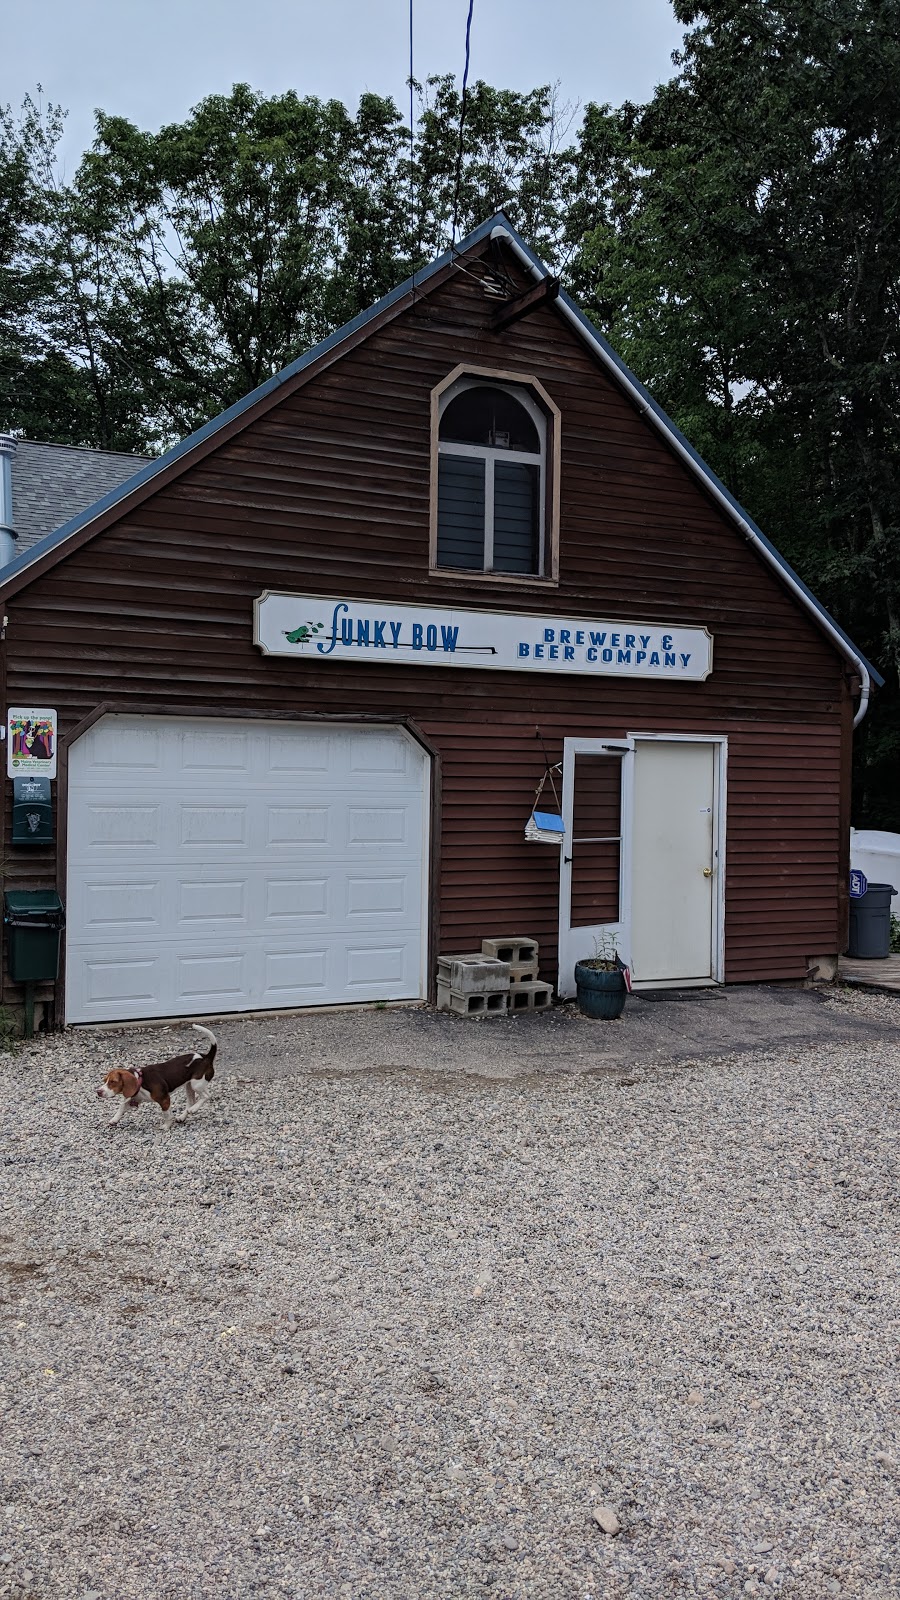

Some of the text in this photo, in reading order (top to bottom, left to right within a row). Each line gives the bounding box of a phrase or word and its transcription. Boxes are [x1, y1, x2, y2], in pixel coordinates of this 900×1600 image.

[412, 623, 459, 652] BOW
[544, 628, 673, 650] BREWERY &
[518, 643, 691, 667] BEER COMPANY
[852, 874, 860, 894] ADT
